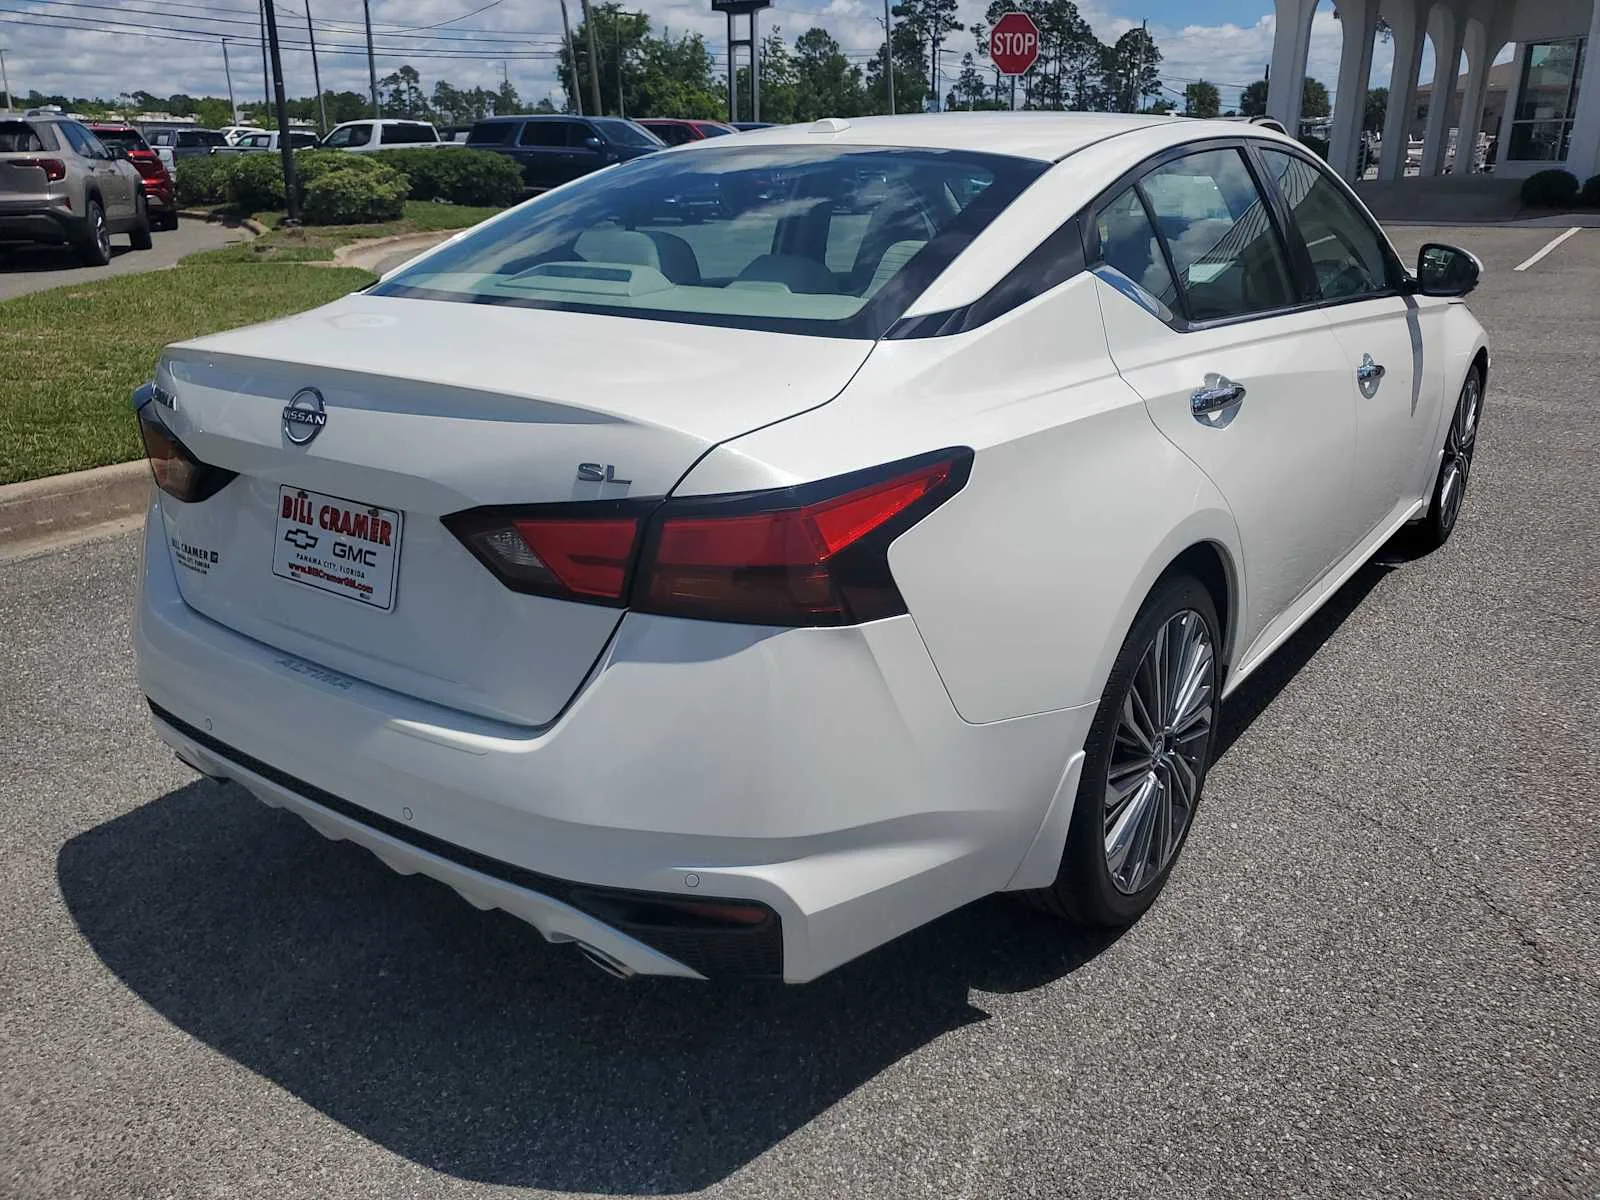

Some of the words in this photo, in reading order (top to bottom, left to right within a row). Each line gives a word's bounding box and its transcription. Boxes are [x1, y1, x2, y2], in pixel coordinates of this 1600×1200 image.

[993, 32, 1035, 55] STOP
[284, 410, 327, 426] NISSAN
[578, 463, 632, 484] SL
[282, 495, 313, 525] BILL
[319, 505, 392, 546] CRAMER
[181, 543, 208, 560] CRAMER
[333, 542, 376, 567] GMC
[296, 553, 322, 566] PANAMA
[339, 565, 365, 578] FLORIDA
